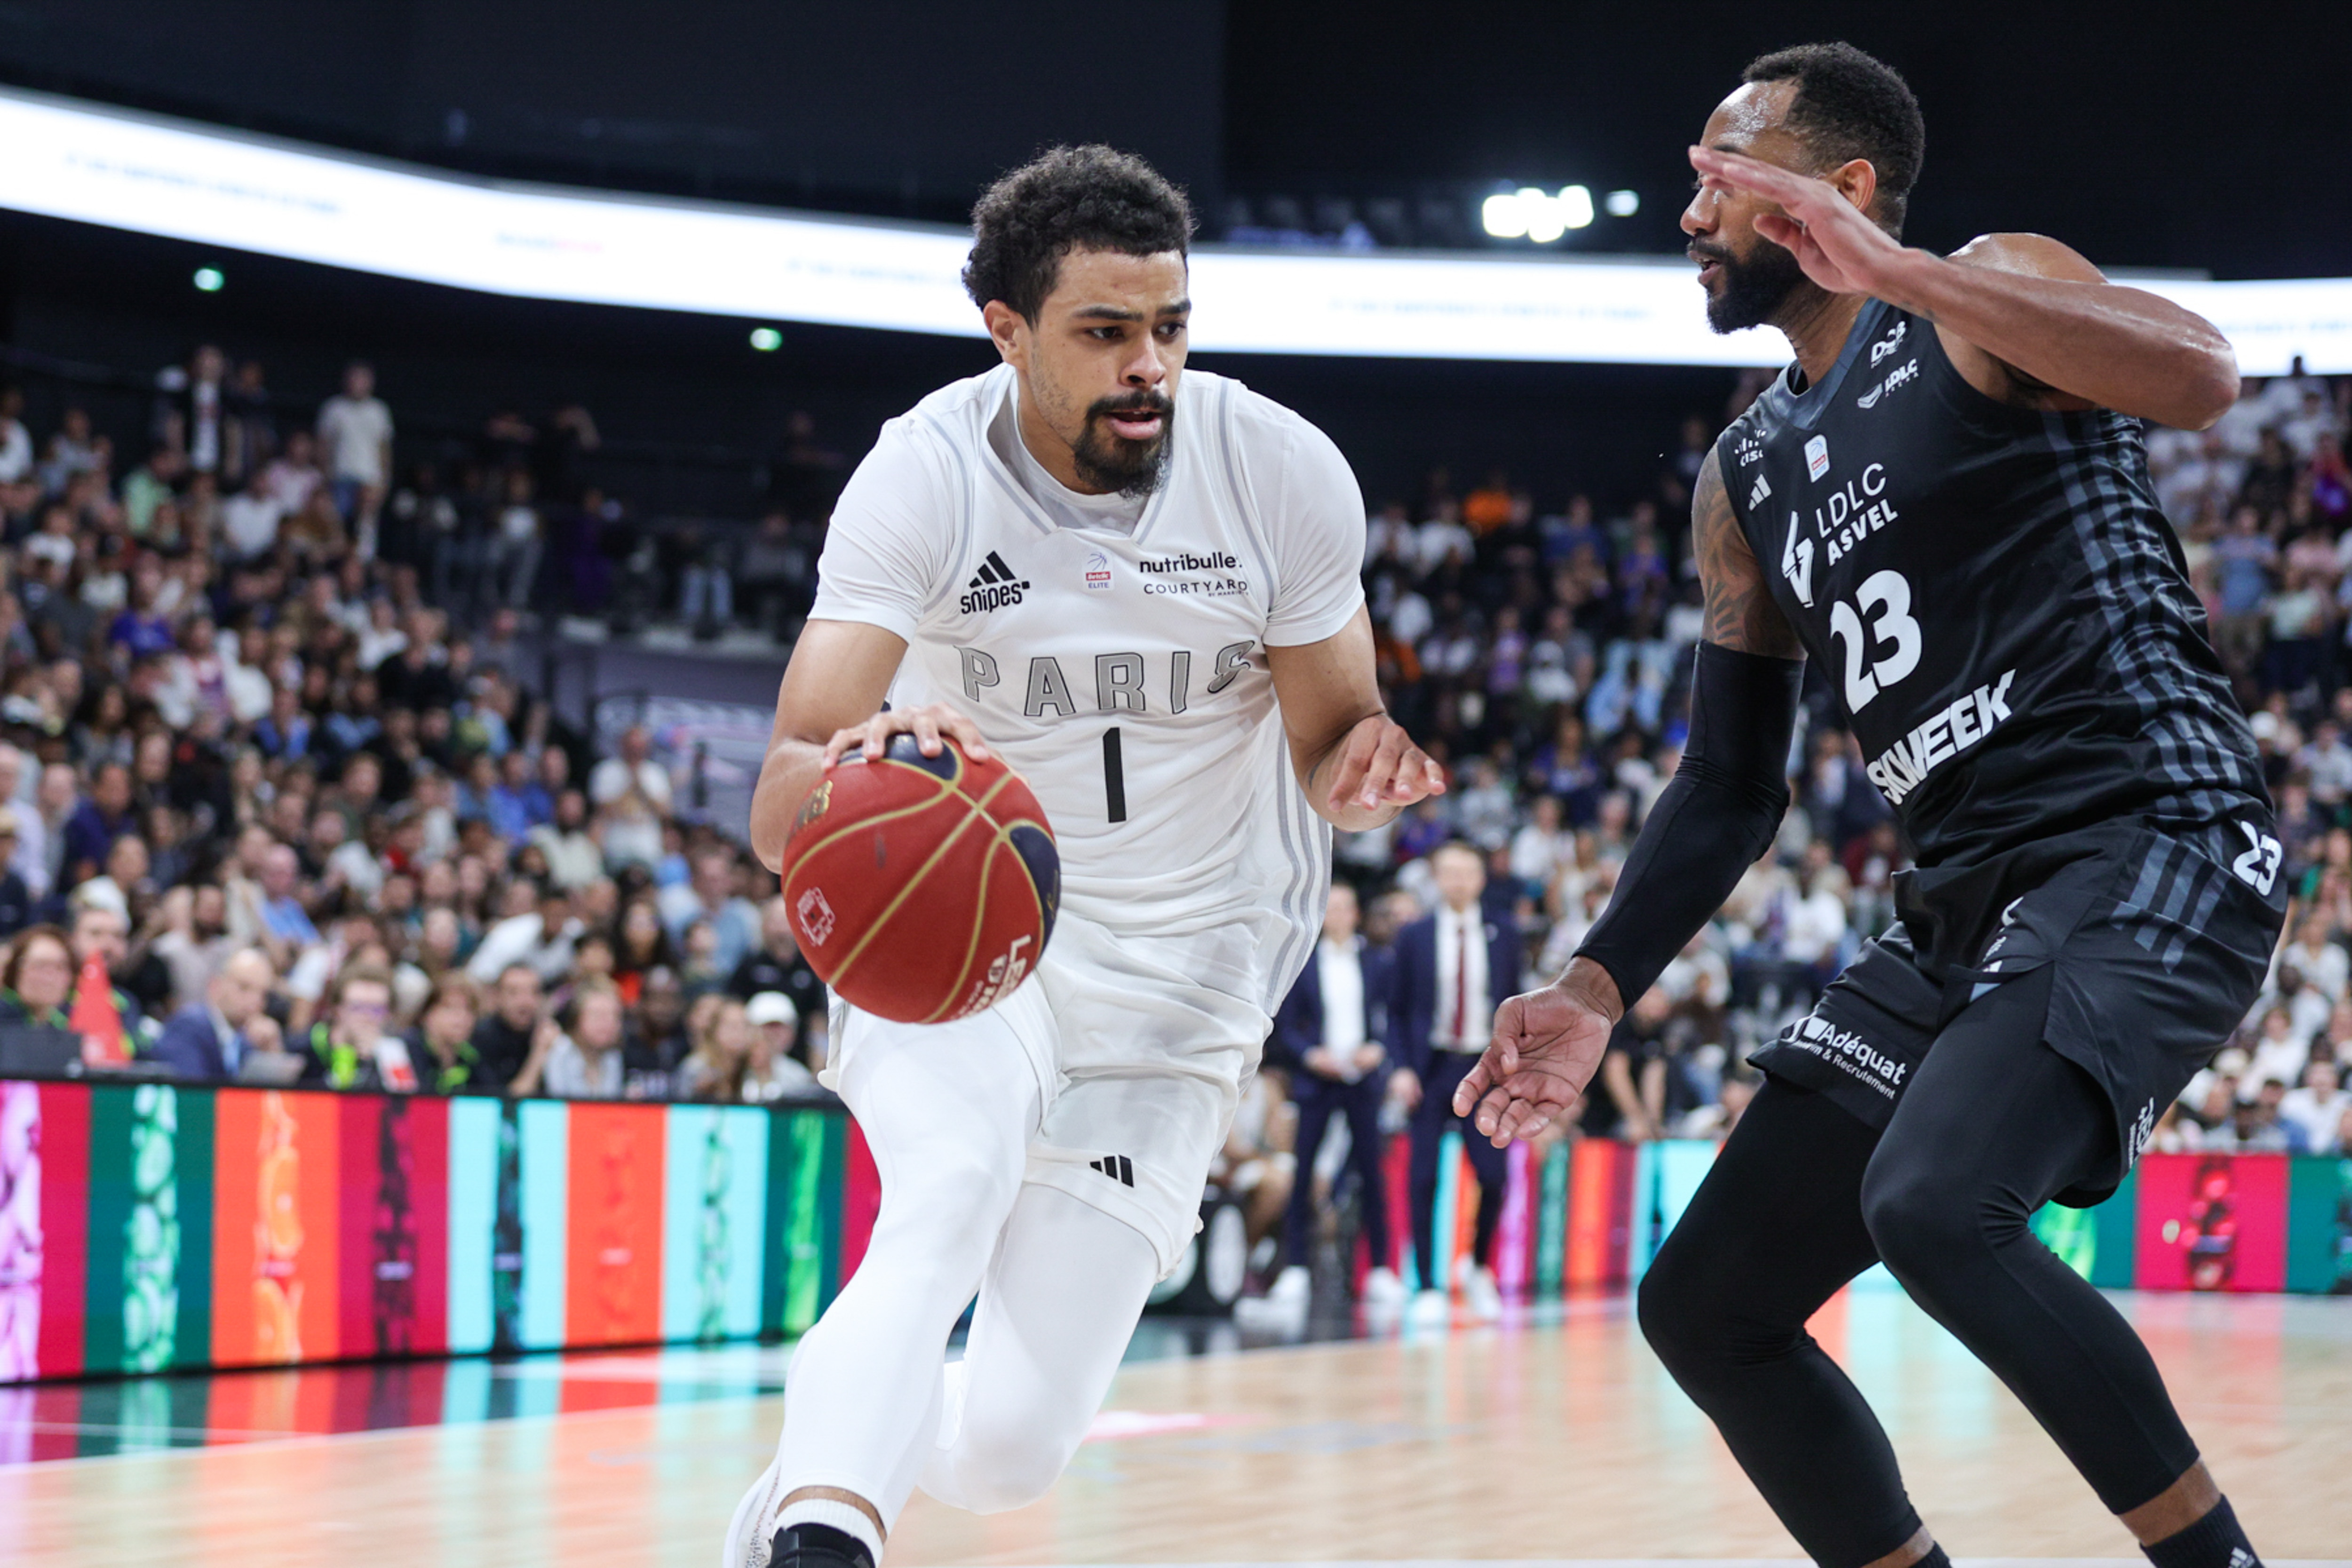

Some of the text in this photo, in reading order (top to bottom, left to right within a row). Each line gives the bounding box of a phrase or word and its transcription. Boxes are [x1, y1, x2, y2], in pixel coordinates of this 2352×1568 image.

[1816, 462, 1886, 539] LDLC
[1828, 498, 1899, 566] ASVEL
[960, 583, 1022, 614] snipes
[1144, 579, 1248, 594] COURTYARD
[954, 640, 1255, 716] PARIS
[1830, 569, 1922, 715] 23
[1103, 727, 1127, 823] 1
[1867, 669, 2016, 805] SKWEEK
[2233, 820, 2282, 896] 23
[1817, 1024, 1906, 1085] Adéquat
[1832, 1054, 1896, 1100] Recrutement
